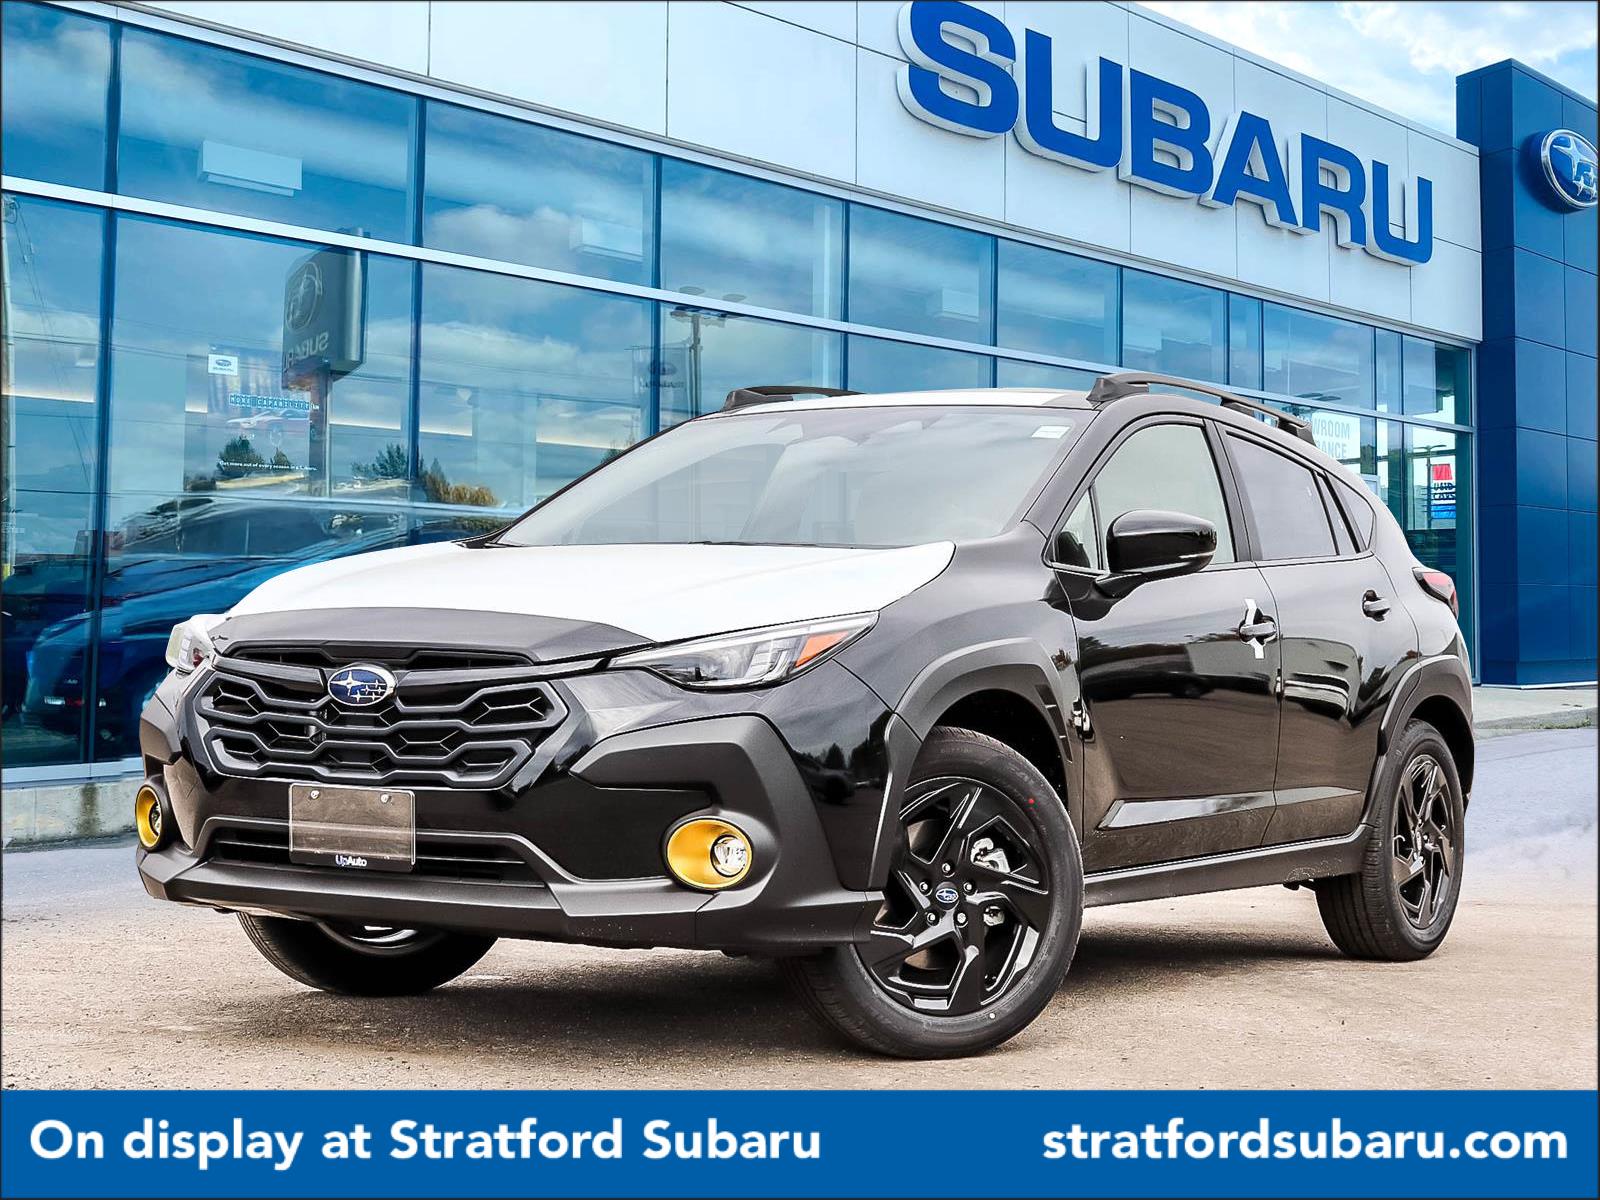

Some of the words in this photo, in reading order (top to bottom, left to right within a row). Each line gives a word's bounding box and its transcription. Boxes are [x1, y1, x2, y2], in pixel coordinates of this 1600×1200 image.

[905, 0, 1434, 264] SUBARU
[1313, 417, 1351, 440] WROOM
[335, 855, 367, 867] UpAuto
